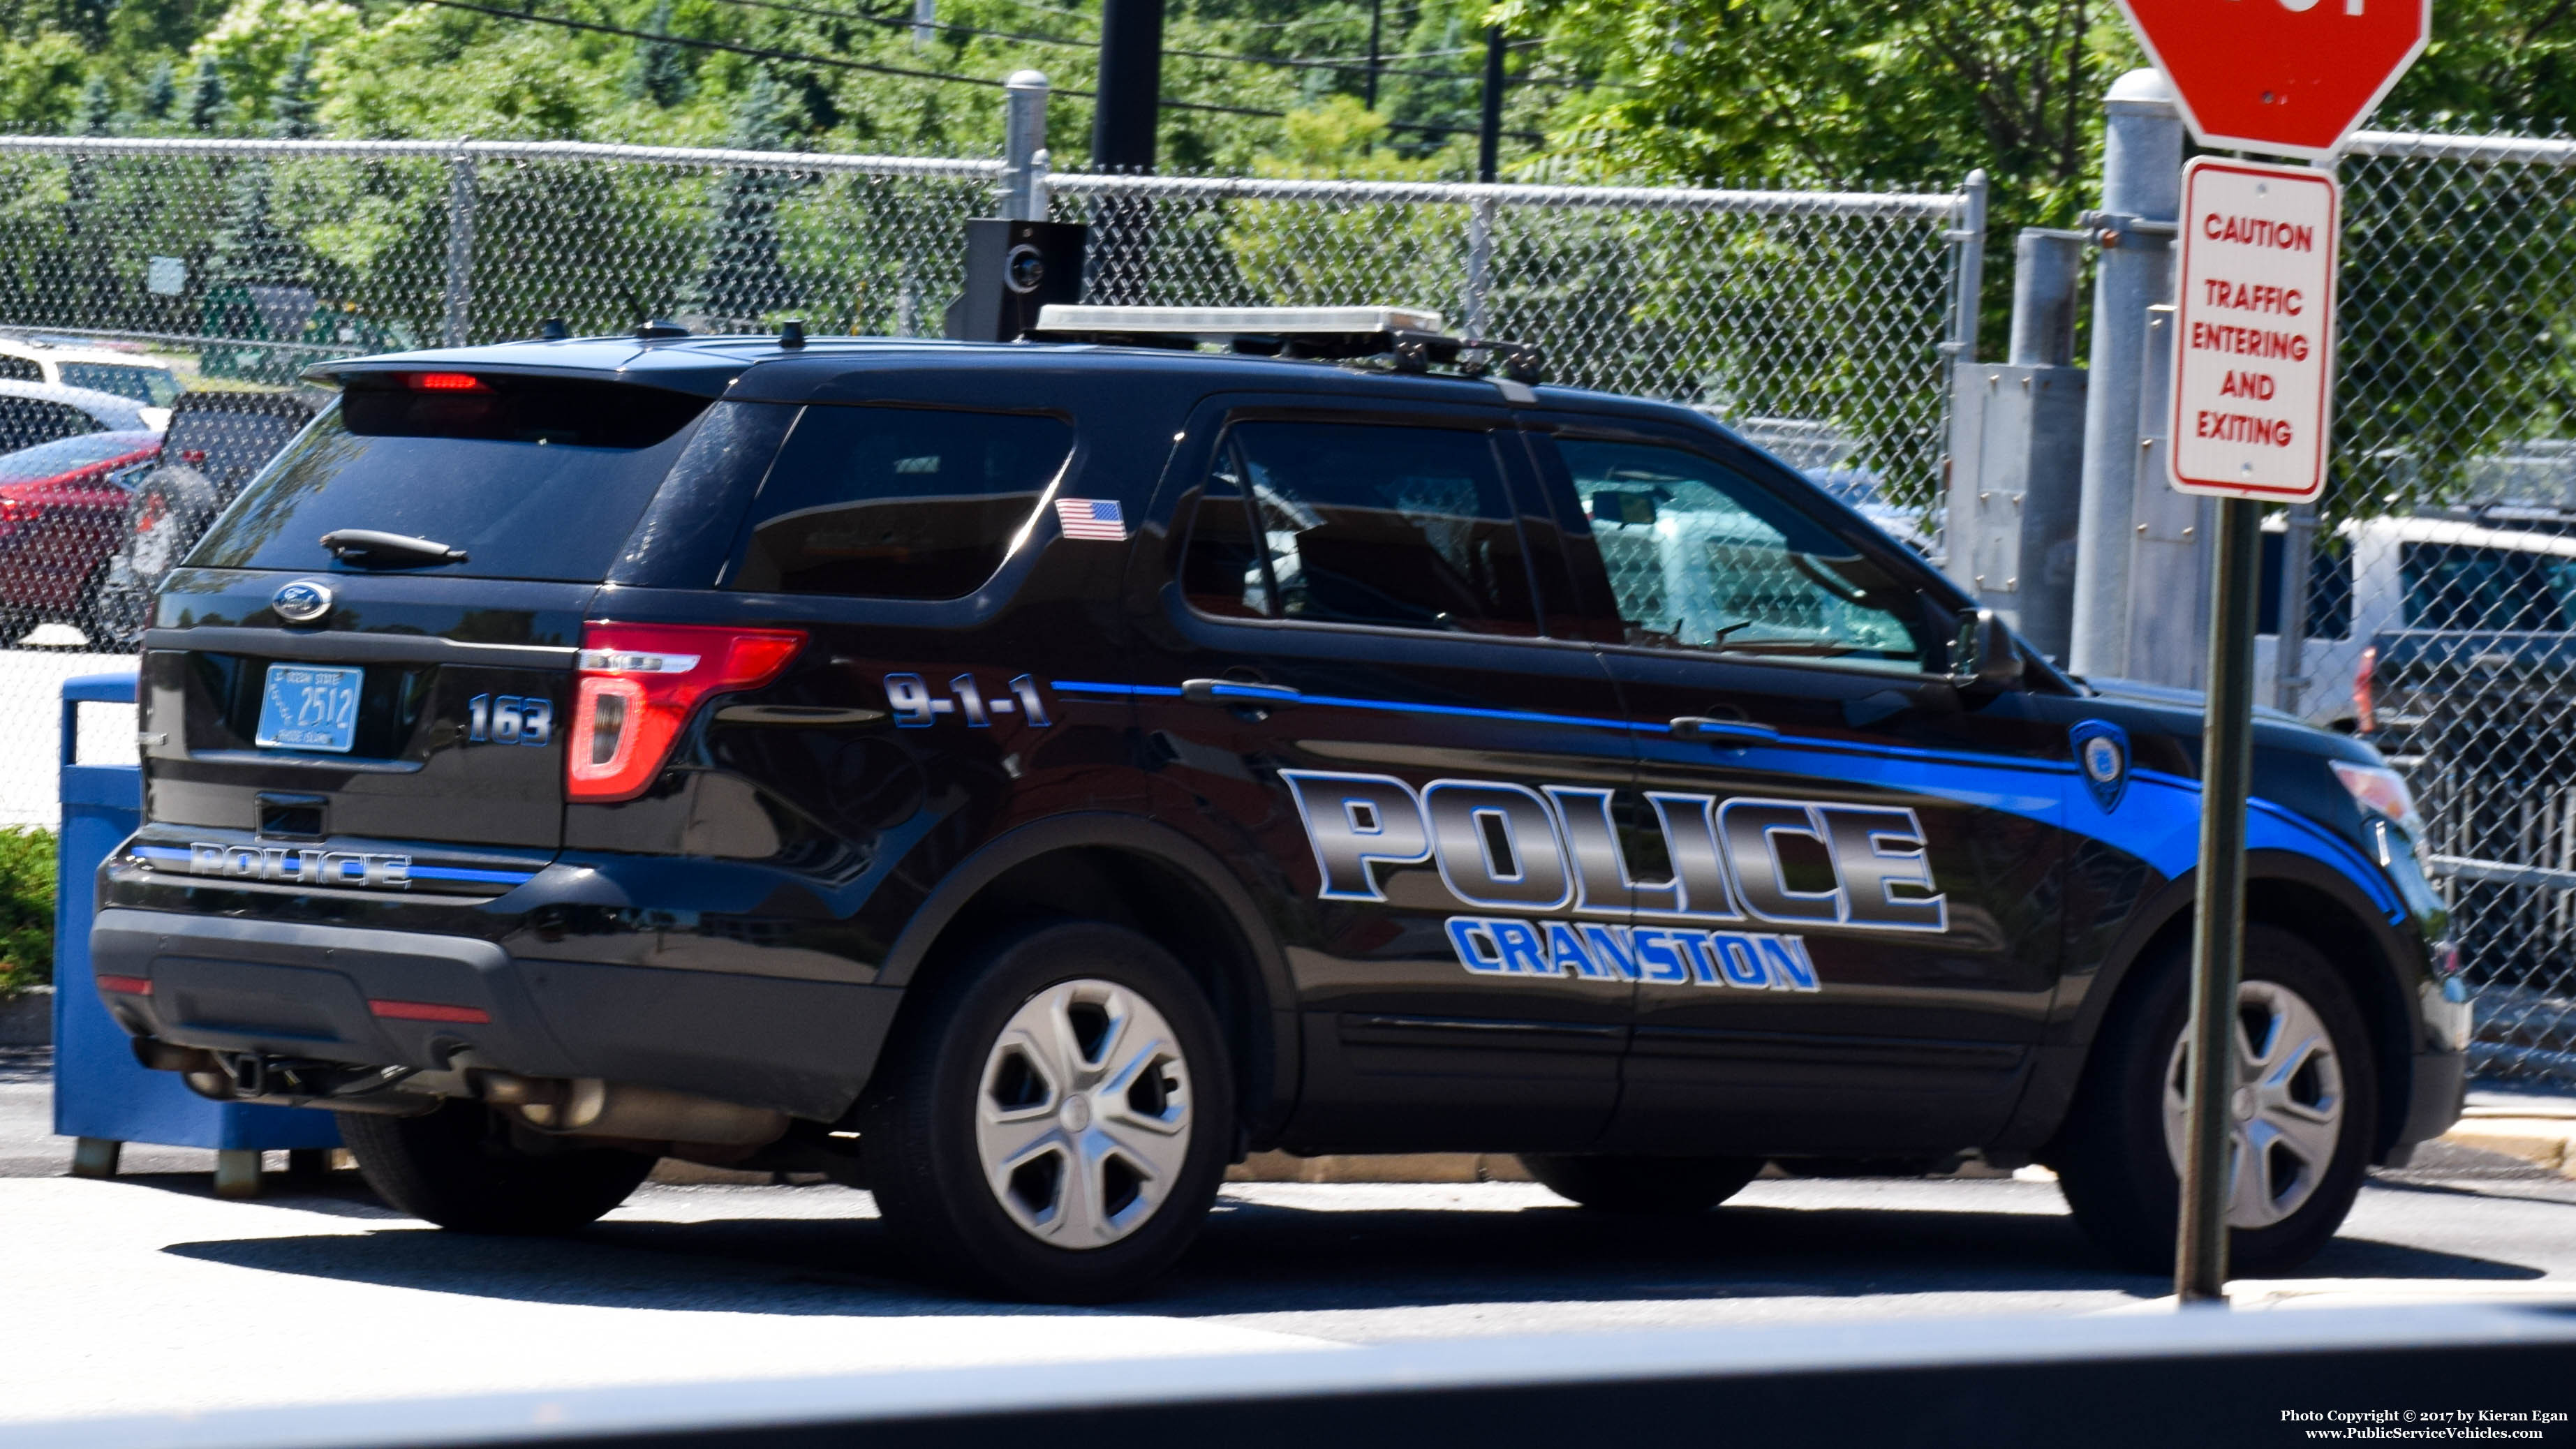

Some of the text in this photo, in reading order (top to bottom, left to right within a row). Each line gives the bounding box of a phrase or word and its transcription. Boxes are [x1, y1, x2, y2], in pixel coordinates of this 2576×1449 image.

[2203, 213, 2314, 252] CAUTION
[2205, 279, 2303, 316] TRAFFIC
[2191, 322, 2309, 362] ENTERING
[2219, 370, 2274, 401] AND
[2197, 410, 2293, 447] EXITING
[315, 672, 343, 685] STATE
[297, 685, 354, 729] 2512
[468, 692, 553, 748] 163
[883, 672, 1052, 728] 9-1-1
[190, 842, 411, 889] POLICE
[1278, 768, 1949, 932] POLICE
[1444, 916, 1821, 992] CRANSTON
